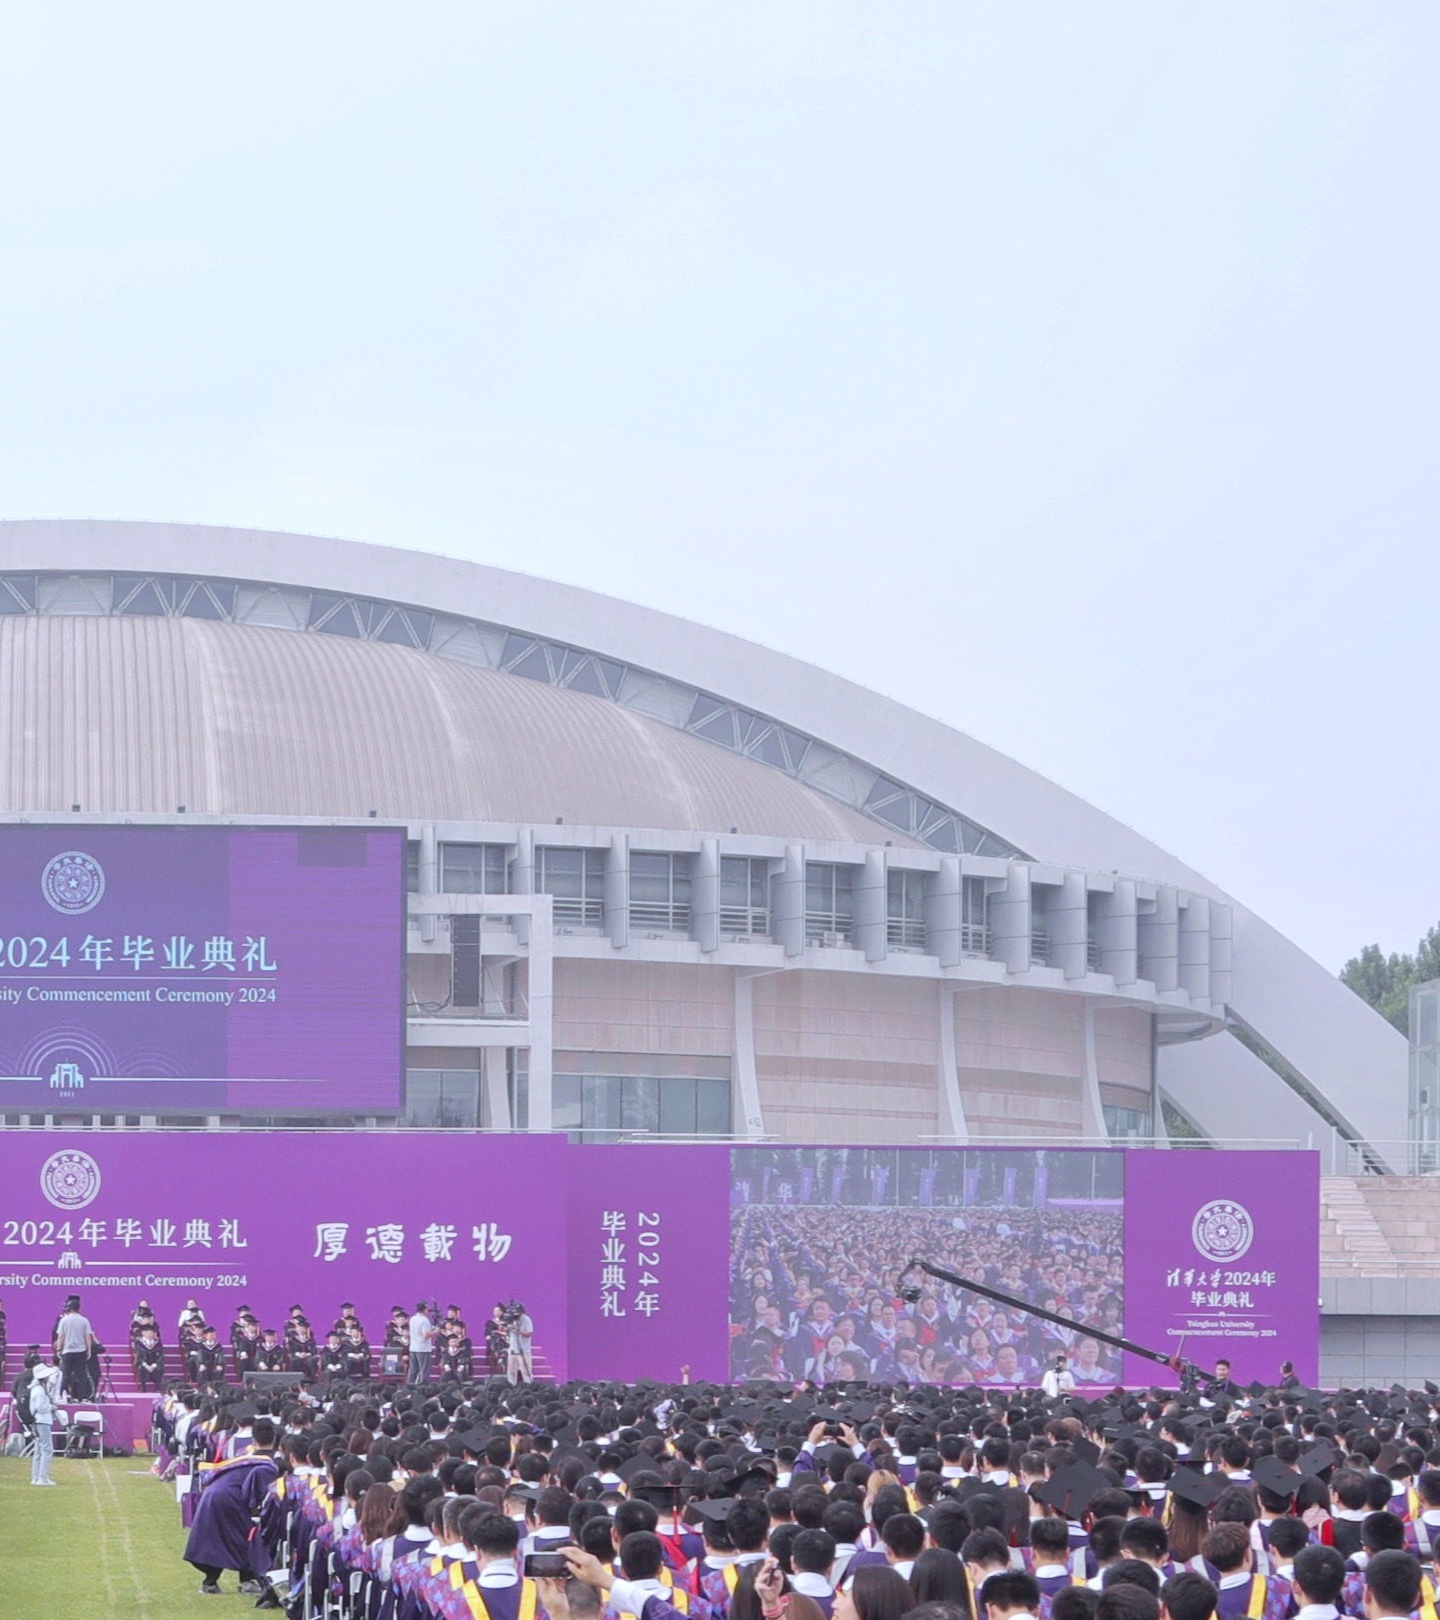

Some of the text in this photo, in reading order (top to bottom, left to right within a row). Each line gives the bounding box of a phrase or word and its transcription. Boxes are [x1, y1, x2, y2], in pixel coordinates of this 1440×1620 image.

[27, 987, 151, 1002] Commencement
[155, 988, 234, 1006] Ceremony
[238, 988, 277, 1003] 2024
[600, 1211, 627, 1317] 毕业典礼
[634, 1212, 661, 1317] 2024年
[31, 1274, 142, 1287] Commencement
[145, 1275, 214, 1289] Ceremony
[217, 1275, 248, 1288] 2024
[1191, 1291, 1254, 1308] 毕业典礼
